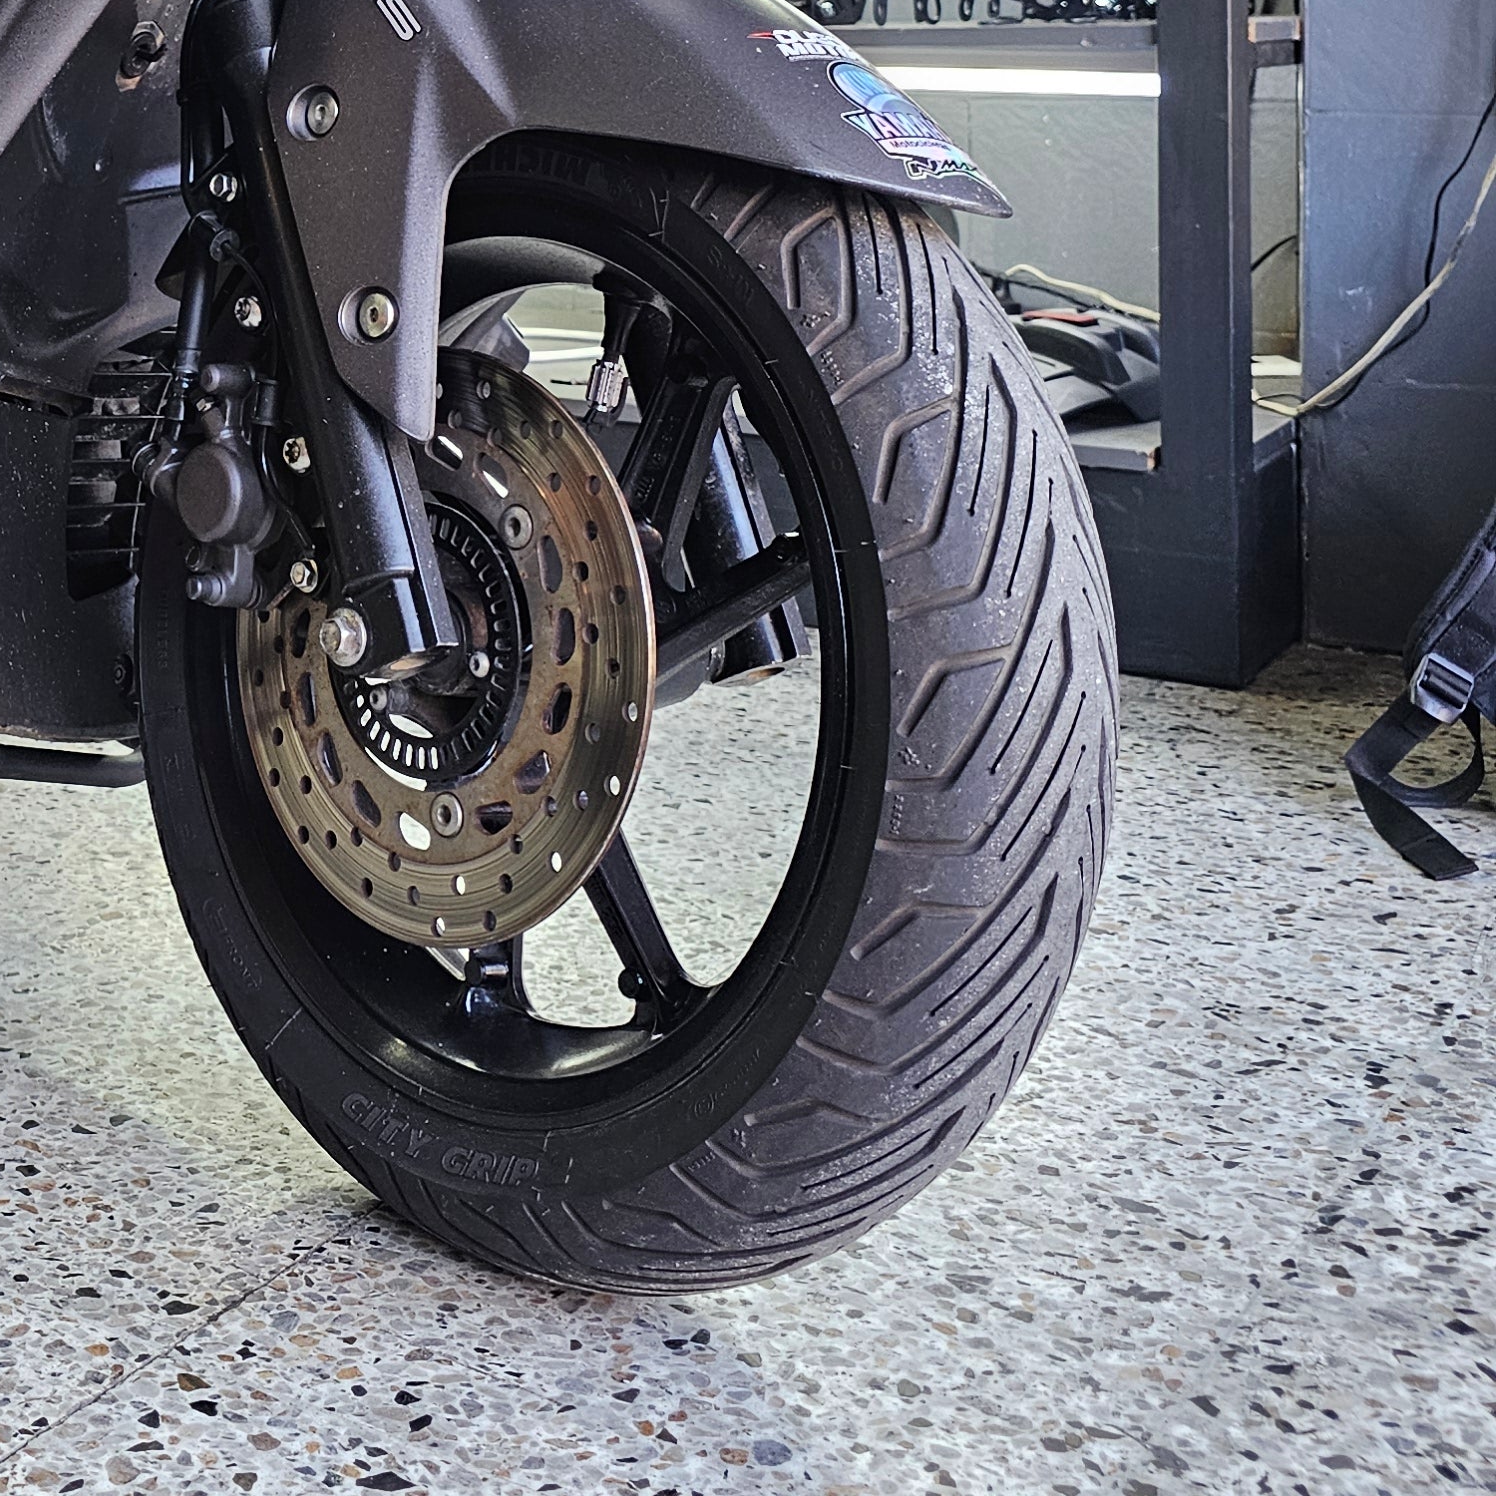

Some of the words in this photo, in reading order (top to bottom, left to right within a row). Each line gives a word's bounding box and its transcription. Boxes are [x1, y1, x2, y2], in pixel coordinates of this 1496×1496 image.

[847, 111, 948, 141] YAMAH
[341, 1092, 435, 1158] CITY
[441, 1146, 541, 1187] GRIP
